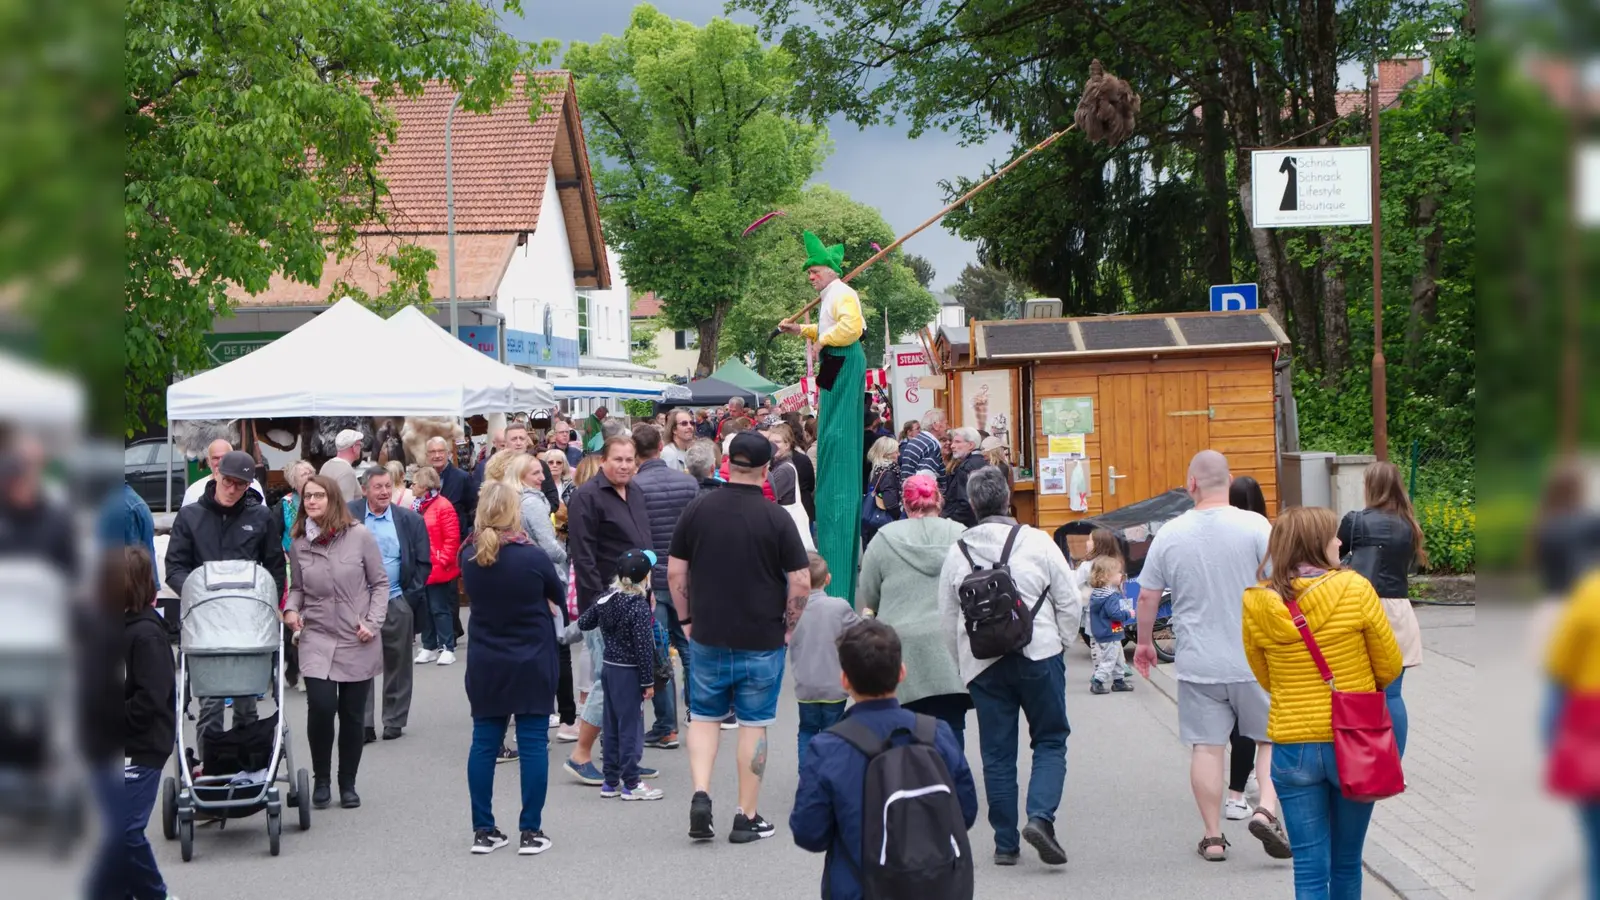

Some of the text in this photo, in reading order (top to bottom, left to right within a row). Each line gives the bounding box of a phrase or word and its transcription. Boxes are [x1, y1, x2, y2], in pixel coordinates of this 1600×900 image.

[1298, 156, 1337, 168] Schnick
[1298, 170, 1342, 182] Schnack
[1299, 184, 1342, 198] Lifestyle
[1299, 200, 1346, 212] Boutique
[1222, 292, 1246, 311] P
[899, 354, 925, 364] STEAKS
